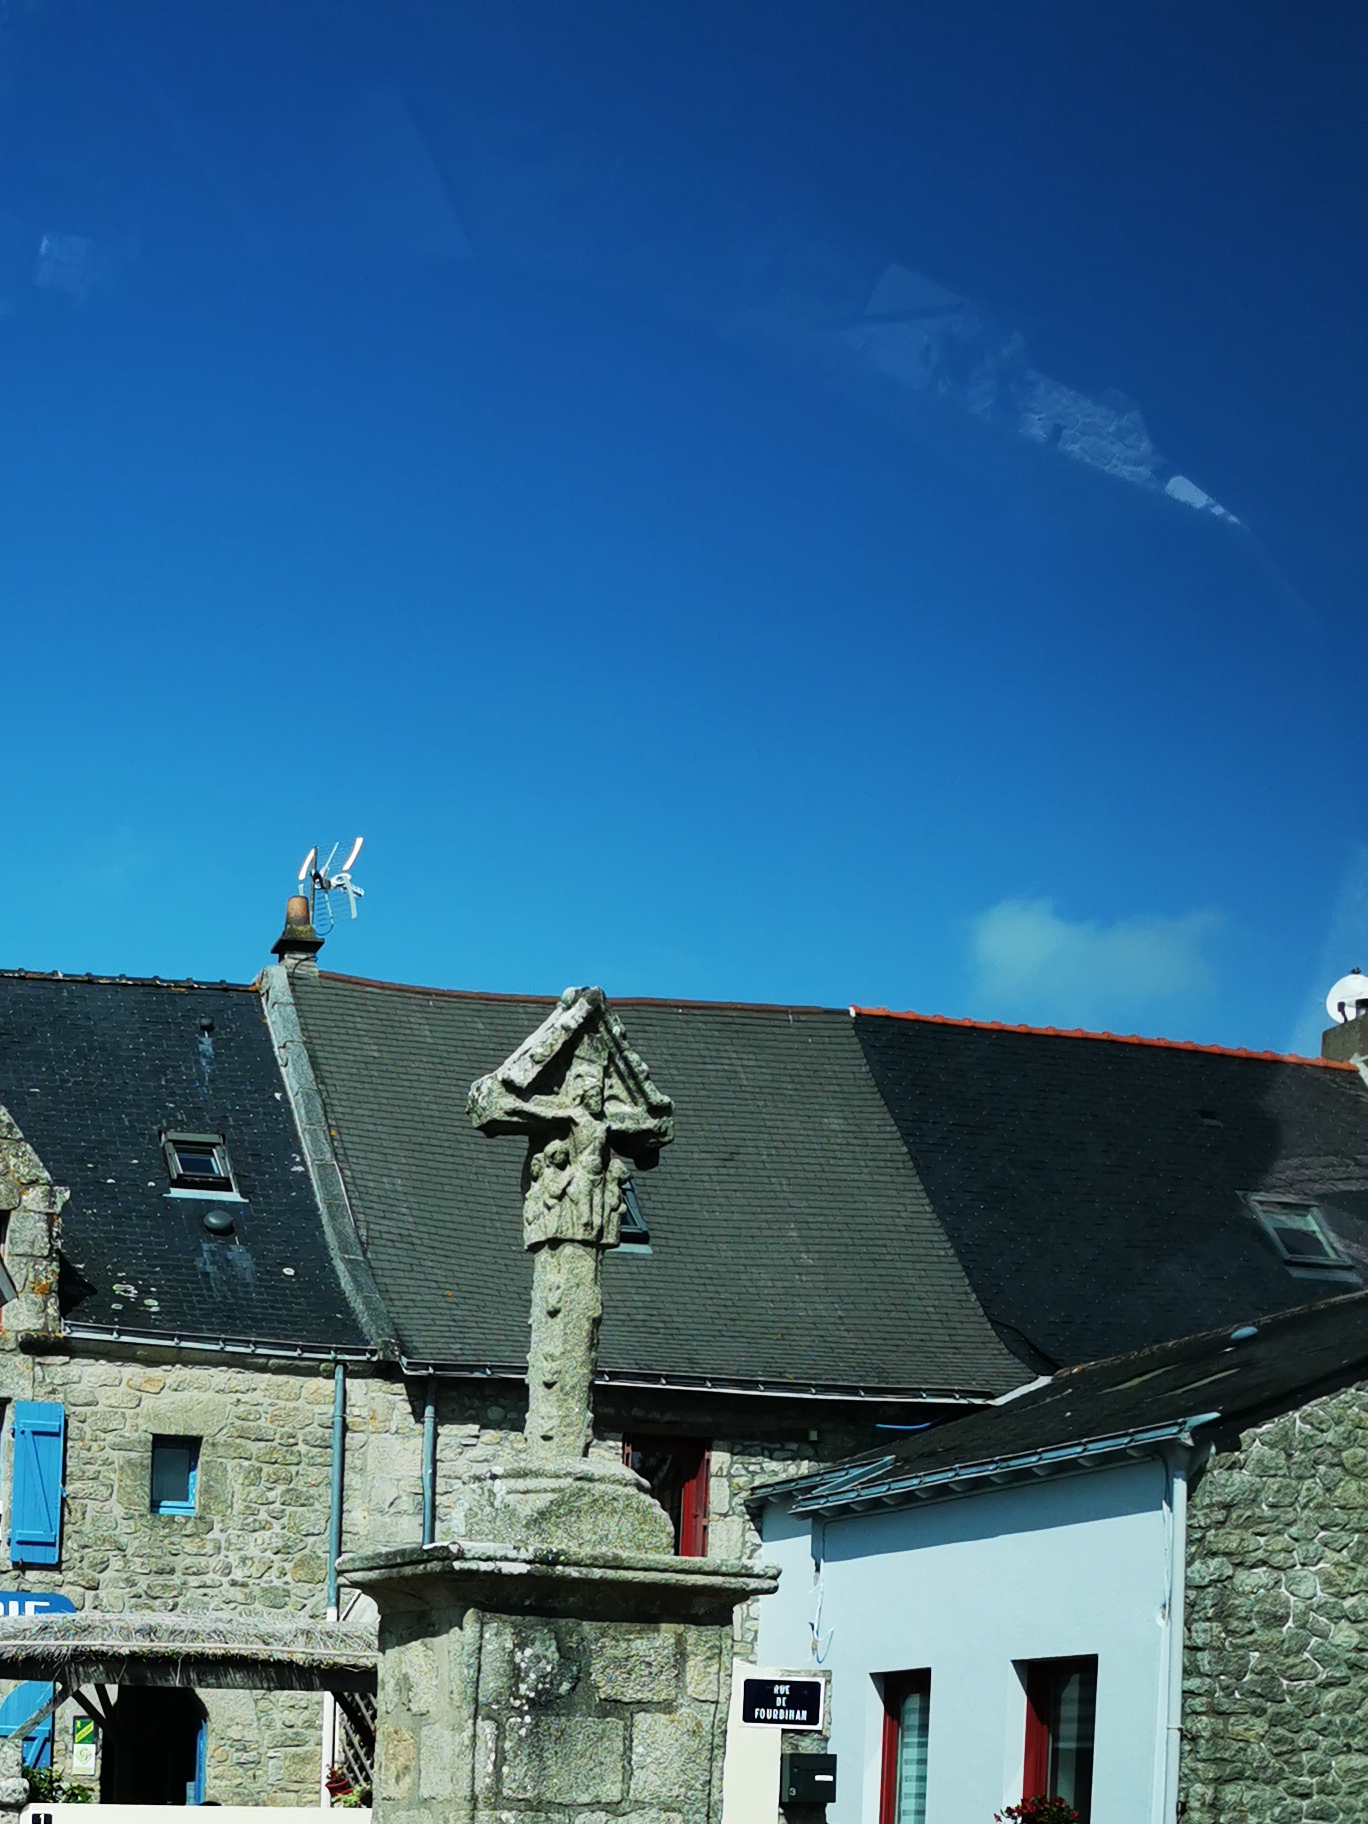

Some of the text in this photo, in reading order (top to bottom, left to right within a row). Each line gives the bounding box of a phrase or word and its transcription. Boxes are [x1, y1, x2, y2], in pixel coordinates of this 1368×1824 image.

[773, 1684, 791, 1695] RUE
[775, 1696, 787, 1707] DE
[789, 1787, 796, 1796] 3
